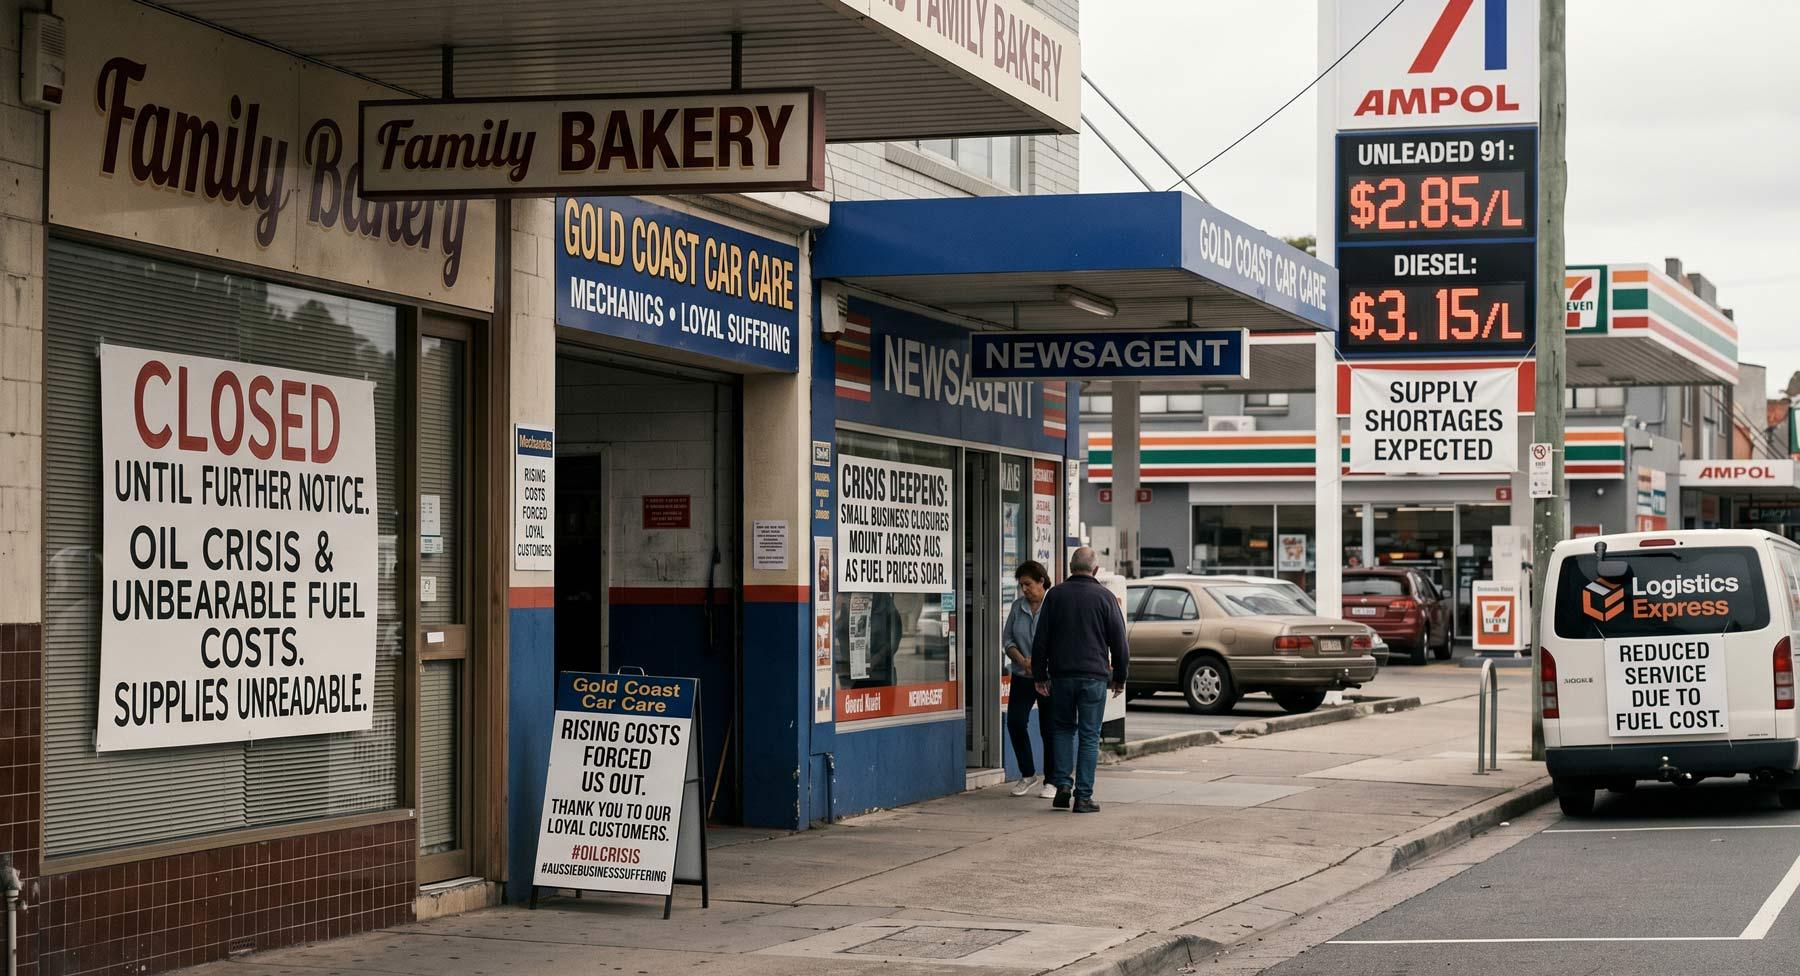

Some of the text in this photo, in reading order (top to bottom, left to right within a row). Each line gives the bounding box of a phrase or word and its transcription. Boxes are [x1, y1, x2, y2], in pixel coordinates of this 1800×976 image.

[994, 3, 1062, 102] BAKERY
[1353, 84, 1519, 116] AMPOL
[95, 56, 290, 247] Family
[377, 104, 795, 182] Family BAKERY
[1358, 139, 1515, 166] UNLEADED 91:
[1350, 175, 1523, 229] $2.85/L
[564, 197, 794, 311] GOLD COAST CAR CARE
[1200, 217, 1326, 311] GOLD COAST CAR CARE
[1394, 253, 1477, 276] DIESEL:
[570, 276, 791, 356] MECHANICS LOYAL SUFFRING
[985, 339, 1228, 369] NEWSAGENT
[1390, 381, 1477, 403] SUPPLY
[134, 359, 340, 463] CLOSED
[1365, 409, 1503, 431] SHORTAGES
[1374, 438, 1493, 460] EXPECTED
[841, 463, 948, 507] CRISIS DEEPENS:
[1699, 466, 1775, 479] AMPOL
[115, 459, 370, 516] UNTIL FURTHER NOTICE.
[524, 487, 546, 501] COSTS
[522, 506, 548, 520] FORCED
[840, 503, 869, 525] SMALL
[871, 506, 909, 529] BUSINESS
[911, 509, 949, 532] CLOSURES
[525, 525, 545, 539] LOYAL
[849, 530, 943, 558] MOUNT ACROSS AUS.
[130, 525, 334, 573] OIL CRISIS &
[845, 559, 947, 585] AS FUEL PRICES SOAR.
[1632, 573, 1739, 599] Logistics
[112, 580, 365, 622] UNBEARABLE FUEL
[1633, 599, 1729, 622] Express
[201, 626, 304, 669] COSTS.
[1620, 642, 1710, 662] REDUCED
[573, 678, 680, 697] Gold Coast
[1625, 665, 1706, 685] SERVICE
[114, 672, 367, 727] SUPPLIES UNREADABLE.
[582, 694, 667, 713] Car Care
[1632, 688, 1700, 707] DUE TO
[561, 718, 681, 745] RISING COSTS
[1616, 710, 1723, 731] FUEL COST.
[583, 745, 651, 770] FORCED
[581, 771, 646, 796] US OUT.
[552, 799, 671, 822] THANK YOU TO OUR
[547, 818, 670, 842] LOYAL CUSTOMERS.
[571, 845, 640, 864] #OILCRISIS
[541, 862, 667, 882] #AUSSIEBUSINESSSUFFERING
